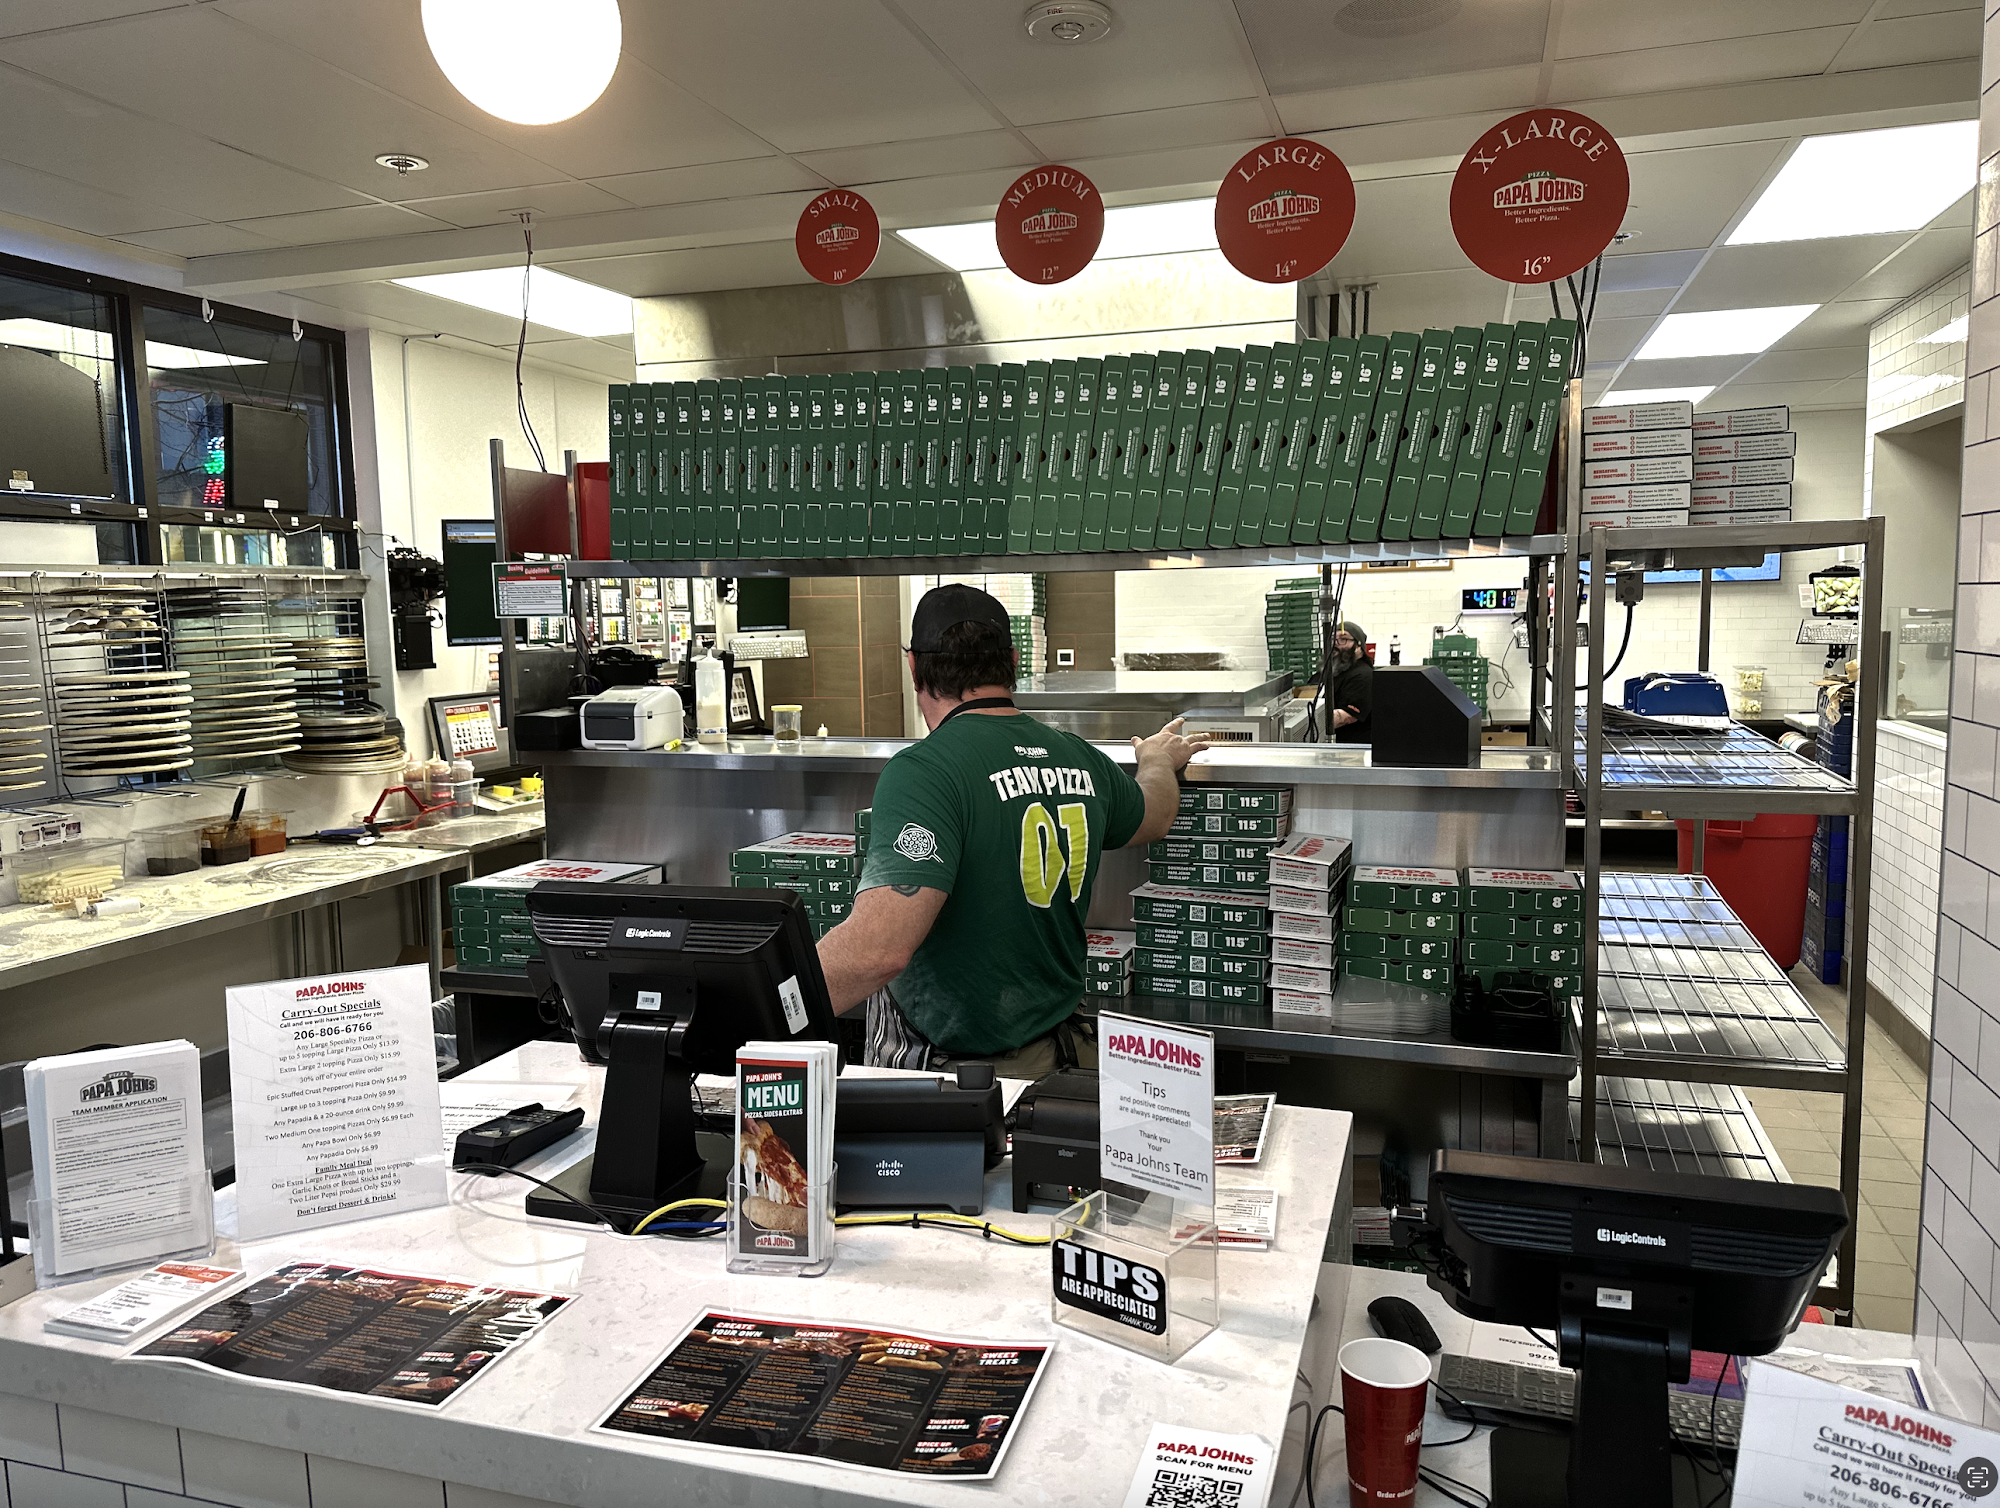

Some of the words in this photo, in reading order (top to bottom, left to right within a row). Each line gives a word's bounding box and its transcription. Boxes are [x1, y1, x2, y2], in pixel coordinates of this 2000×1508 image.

[1470, 118, 1609, 173] X-LARGE
[1238, 145, 1326, 183] LARGE
[1527, 170, 1550, 179] PIZZA
[1007, 171, 1091, 208] MEDIUM
[1496, 182, 1533, 207] PAPA
[809, 194, 860, 218] SMALL
[1250, 200, 1279, 221] PAPA
[1528, 205, 1571, 215] Ingredients.
[1023, 215, 1046, 233] PAPA
[1515, 216, 1538, 224] Better
[1539, 214, 1560, 222] Pizza.
[817, 229, 835, 243] PAPA
[524, 567, 550, 575] Guidelines
[1041, 767, 1096, 797] PIZZA
[1020, 802, 1089, 909] 01
[295, 985, 326, 998] PAPA
[327, 982, 364, 995] JOHNS
[281, 1005, 338, 1019] Carry-Out
[340, 999, 381, 1012] Specials
[346, 1013, 362, 1021] ready
[293, 1022, 373, 1040] 206-806-6766
[1109, 1035, 1146, 1057] PAPA
[1148, 1038, 1201, 1068] JOHNS
[1109, 1051, 1126, 1060] Better
[1127, 1055, 1162, 1069] Ingredients.
[1163, 1063, 1182, 1073] Better
[1183, 1068, 1202, 1077] Pizza.
[281, 1090, 304, 1099] Stuffed
[305, 1087, 322, 1095] Crust
[322, 1083, 354, 1093] Pepperoni
[371, 1077, 385, 1085] Only
[387, 1074, 407, 1083] $14.99
[746, 1074, 760, 1082] PAPA
[82, 1081, 114, 1100] PAPA
[748, 1084, 799, 1108] MENU
[1142, 1081, 1166, 1099] Tips
[72, 1107, 91, 1115] TEAM
[93, 1103, 122, 1112] MEMBER
[125, 1096, 168, 1107] APPLICATION
[783, 1108, 803, 1116] EXTRAS
[1120, 1095, 1131, 1103] and
[1132, 1097, 1156, 1109] positive
[1157, 1104, 1191, 1117] comments
[1130, 1108, 1151, 1118] always
[1151, 1113, 1191, 1128] appreciated!
[1139, 1129, 1158, 1140] Thank
[1158, 1136, 1171, 1144] you
[1147, 1142, 1162, 1152] Your
[315, 1164, 338, 1174] Family
[340, 1161, 356, 1170] Meal
[357, 1158, 372, 1167] Deal
[1105, 1144, 1133, 1163] Papa
[1136, 1153, 1171, 1173] Johns
[1173, 1162, 1208, 1183] Team
[1058, 1241, 1159, 1301] TIPS
[1062, 1276, 1081, 1295] ARE
[1083, 1283, 1156, 1320] APPRECIATED
[715, 1322, 755, 1330] CREATE
[1120, 1314, 1141, 1326] THANK
[710, 1328, 736, 1336] YOUR
[886, 1347, 918, 1356] SIDES
[891, 1341, 933, 1350] CHOOSE
[1845, 1404, 1889, 1429] PAPA
[1890, 1414, 1953, 1448] JOHNS
[1156, 1442, 1200, 1456] PAPA
[1200, 1446, 1254, 1465] JOHNS
[1818, 1426, 1904, 1462] Carry-Out
[1907, 1453, 1960, 1481] Specia
[1155, 1454, 1187, 1465] SCAN
[1190, 1461, 1214, 1470] FOR
[1216, 1465, 1253, 1477] MENU
[1813, 1443, 1829, 1454] Call
[1831, 1448, 1848, 1460] and
[1850, 1454, 1862, 1464] we
[1864, 1458, 1880, 1471] will
[1882, 1464, 1904, 1478] have
[1905, 1470, 1912, 1480] it
[1915, 1475, 1940, 1491] ready
[1943, 1484, 1957, 1495] for
[1376, 1490, 1396, 1498] Order
